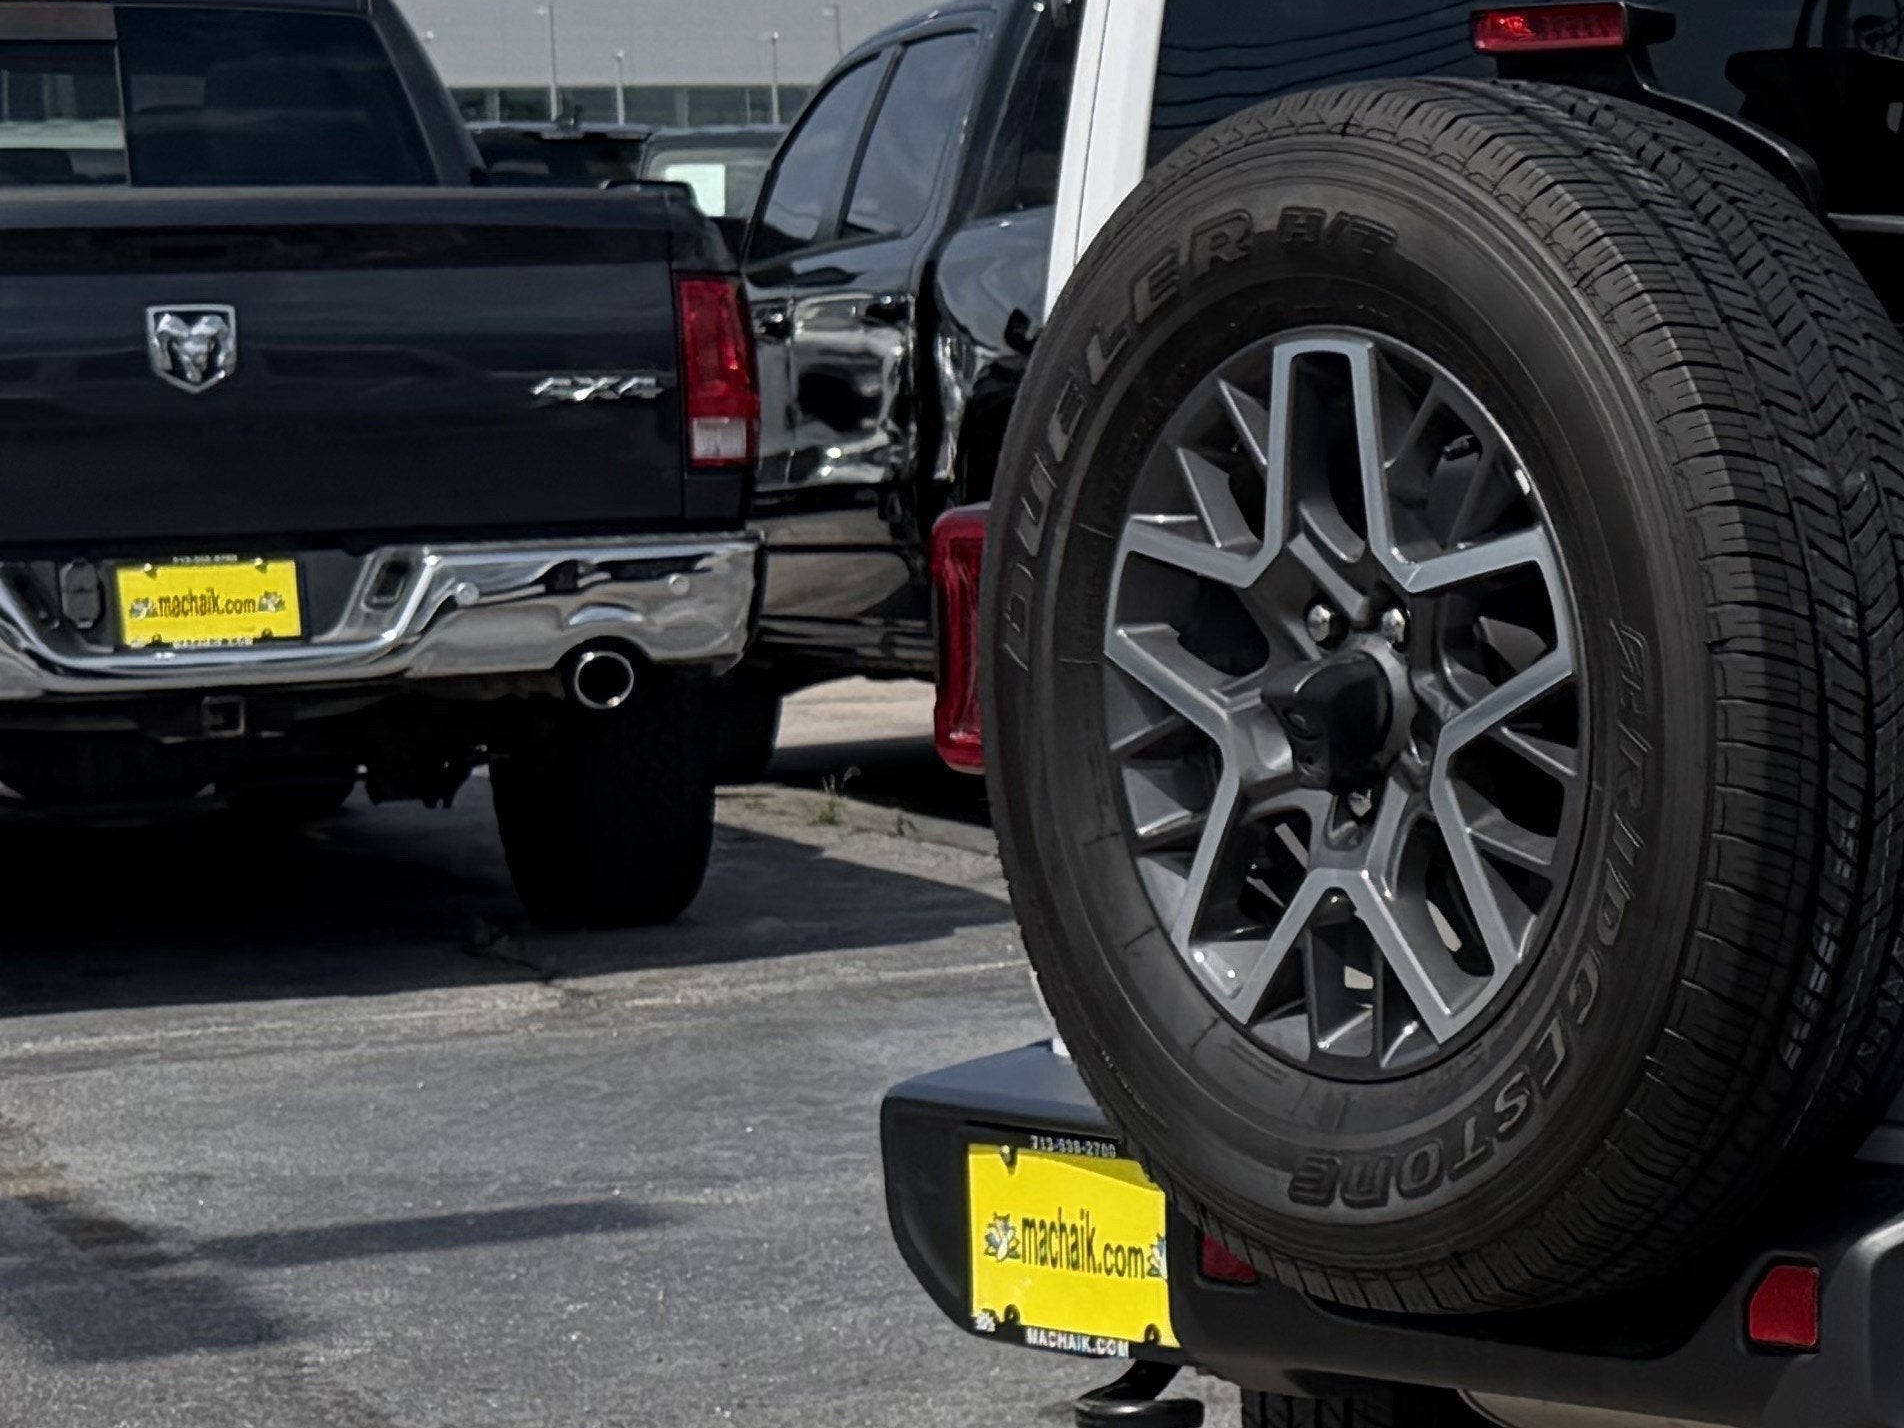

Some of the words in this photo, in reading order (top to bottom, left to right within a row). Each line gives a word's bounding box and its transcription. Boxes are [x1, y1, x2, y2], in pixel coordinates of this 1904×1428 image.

[158, 586, 256, 618] machaik.com
[1287, 617, 1653, 1210] BRIDGESTONE
[1021, 1205, 1145, 1279] machaik.com
[1026, 1327, 1129, 1358] MACHAIK.COM
